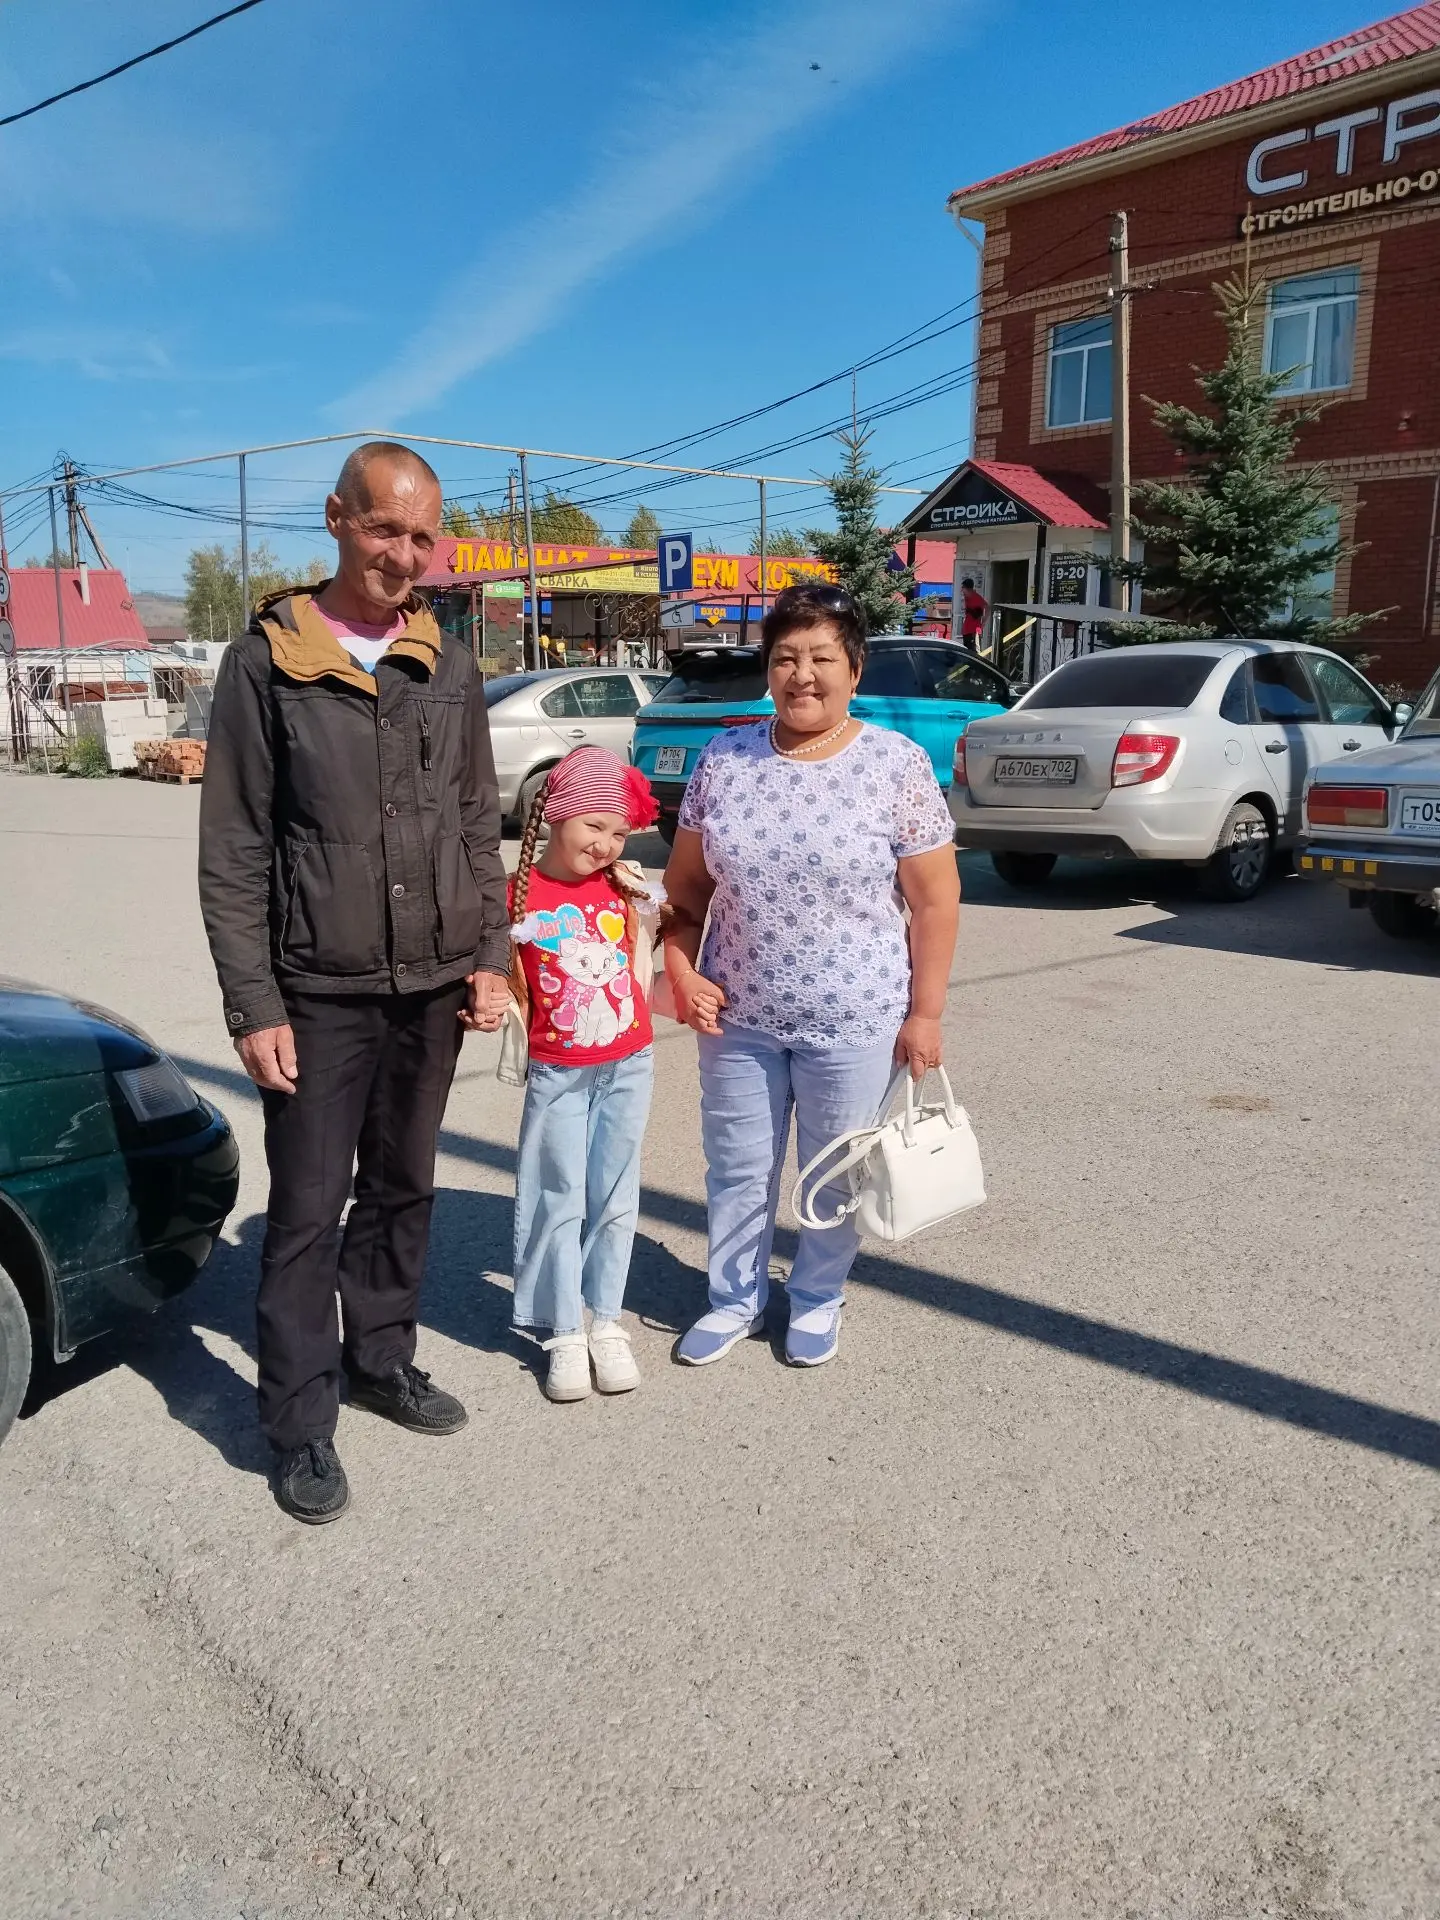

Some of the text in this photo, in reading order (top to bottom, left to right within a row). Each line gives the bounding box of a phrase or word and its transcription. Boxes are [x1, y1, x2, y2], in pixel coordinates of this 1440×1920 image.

[1246, 89, 1440, 195] СТР
[1241, 168, 1440, 233] СТРОИТЕЛЬНО-О
[930, 500, 1018, 523] СТРОЙКА
[539, 574, 589, 588] СВАРКА
[665, 541, 687, 587] P
[1056, 566, 1086, 580] 9-20
